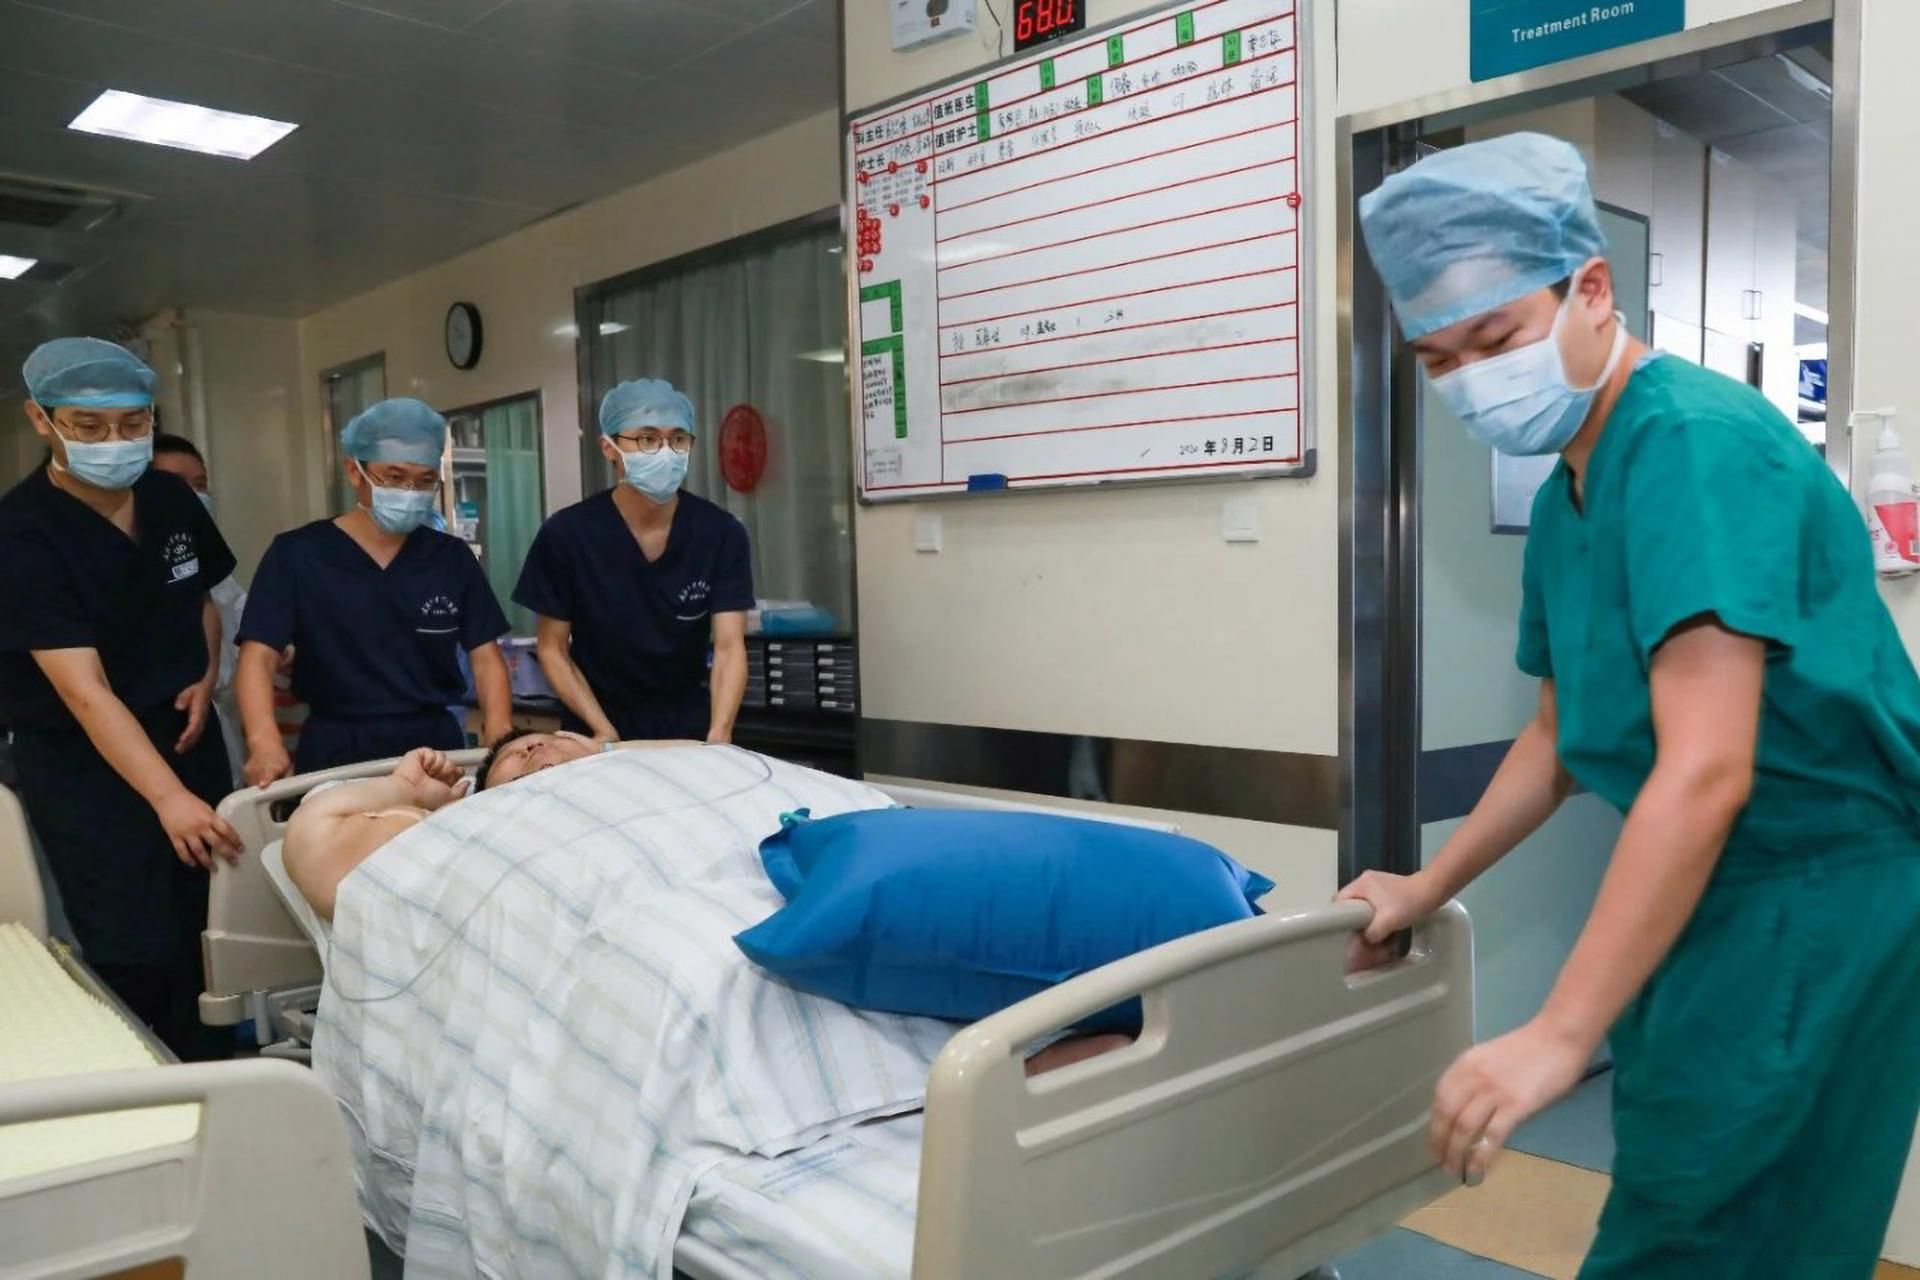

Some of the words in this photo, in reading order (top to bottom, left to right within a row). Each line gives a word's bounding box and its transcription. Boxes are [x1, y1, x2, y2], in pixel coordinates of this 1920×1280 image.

[1511, 12, 1587, 42] Treatment
[1590, 2, 1634, 22] Room
[935, 124, 977, 148] 值班护士
